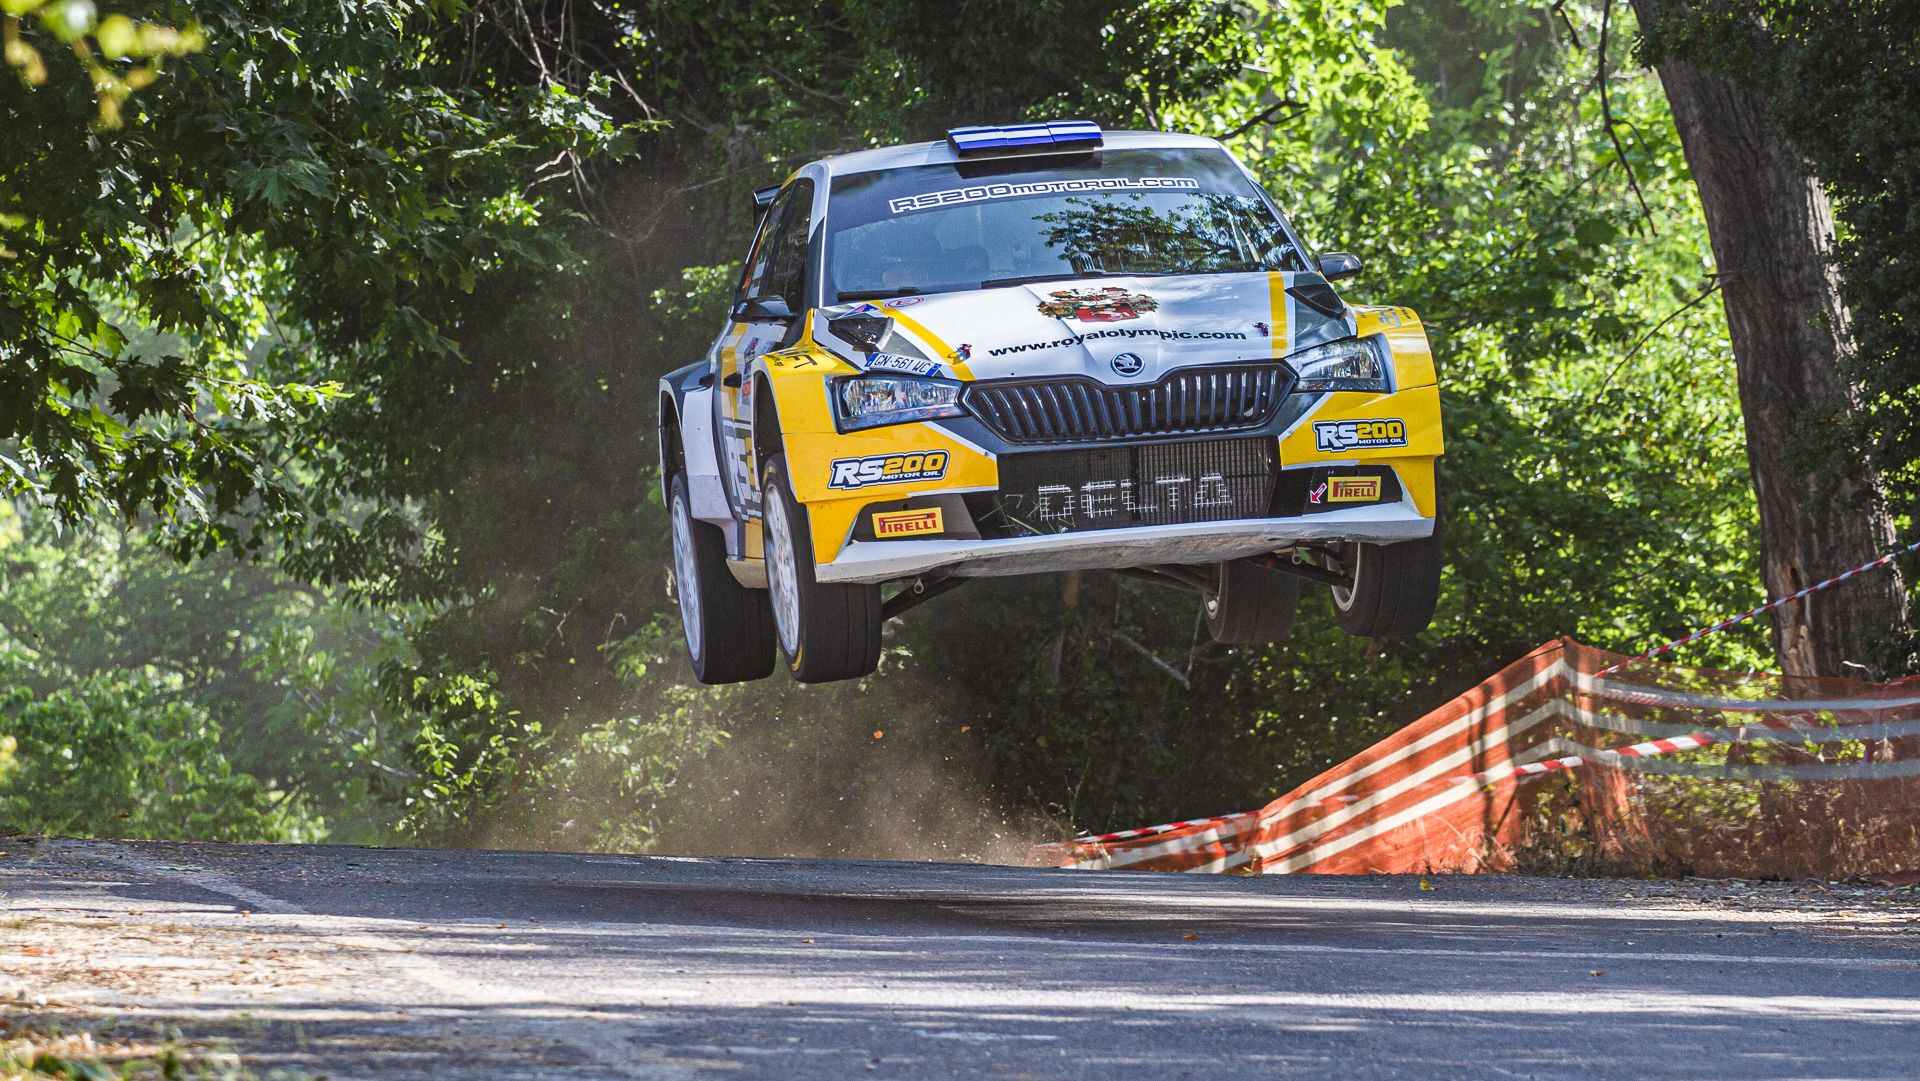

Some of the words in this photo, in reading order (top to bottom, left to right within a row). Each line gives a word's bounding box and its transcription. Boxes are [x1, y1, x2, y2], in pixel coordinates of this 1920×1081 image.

[988, 328, 1247, 357] www.royalolympic.com
[1316, 422, 1403, 447] RS200
[833, 453, 946, 485] RS200
[881, 471, 921, 480] MOTOR
[1038, 473, 1232, 521] DELTA
[1332, 480, 1378, 498] PIRELLI
[878, 512, 937, 534] PIRELLI
